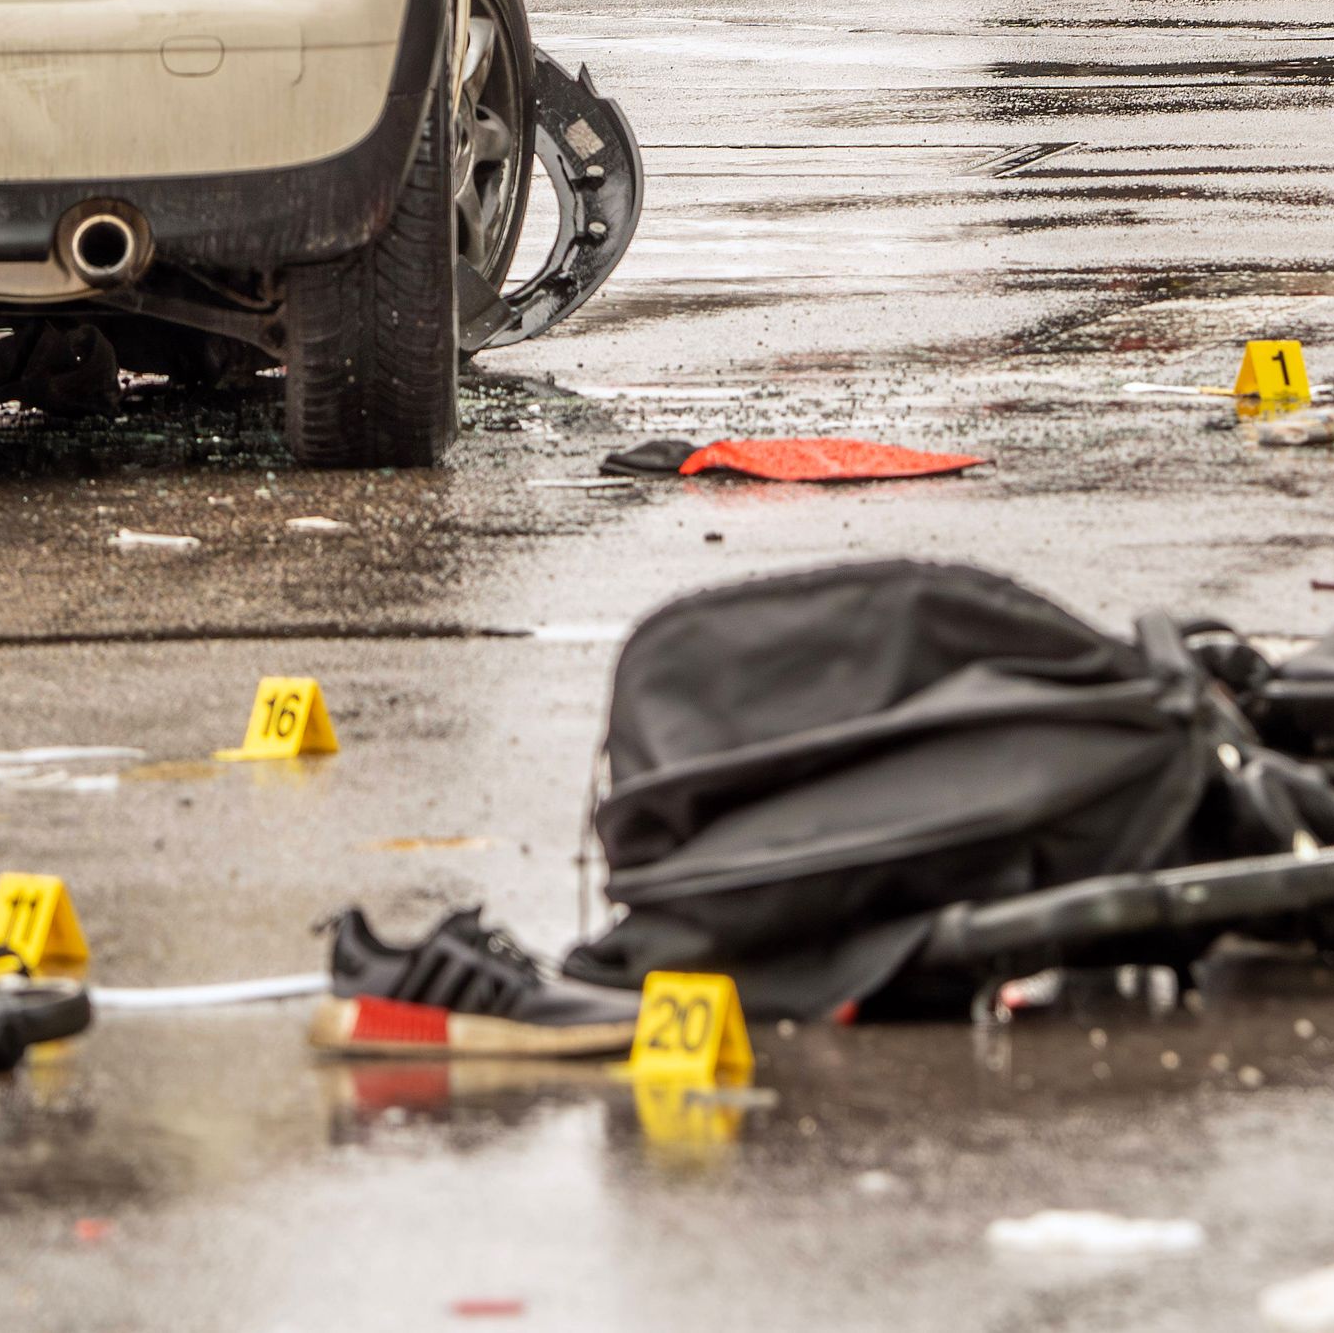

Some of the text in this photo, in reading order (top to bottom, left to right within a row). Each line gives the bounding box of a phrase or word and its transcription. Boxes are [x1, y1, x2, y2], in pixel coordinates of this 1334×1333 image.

[1271, 350, 1291, 386] 1
[262, 692, 301, 739] 16
[647, 994, 712, 1052] 20
